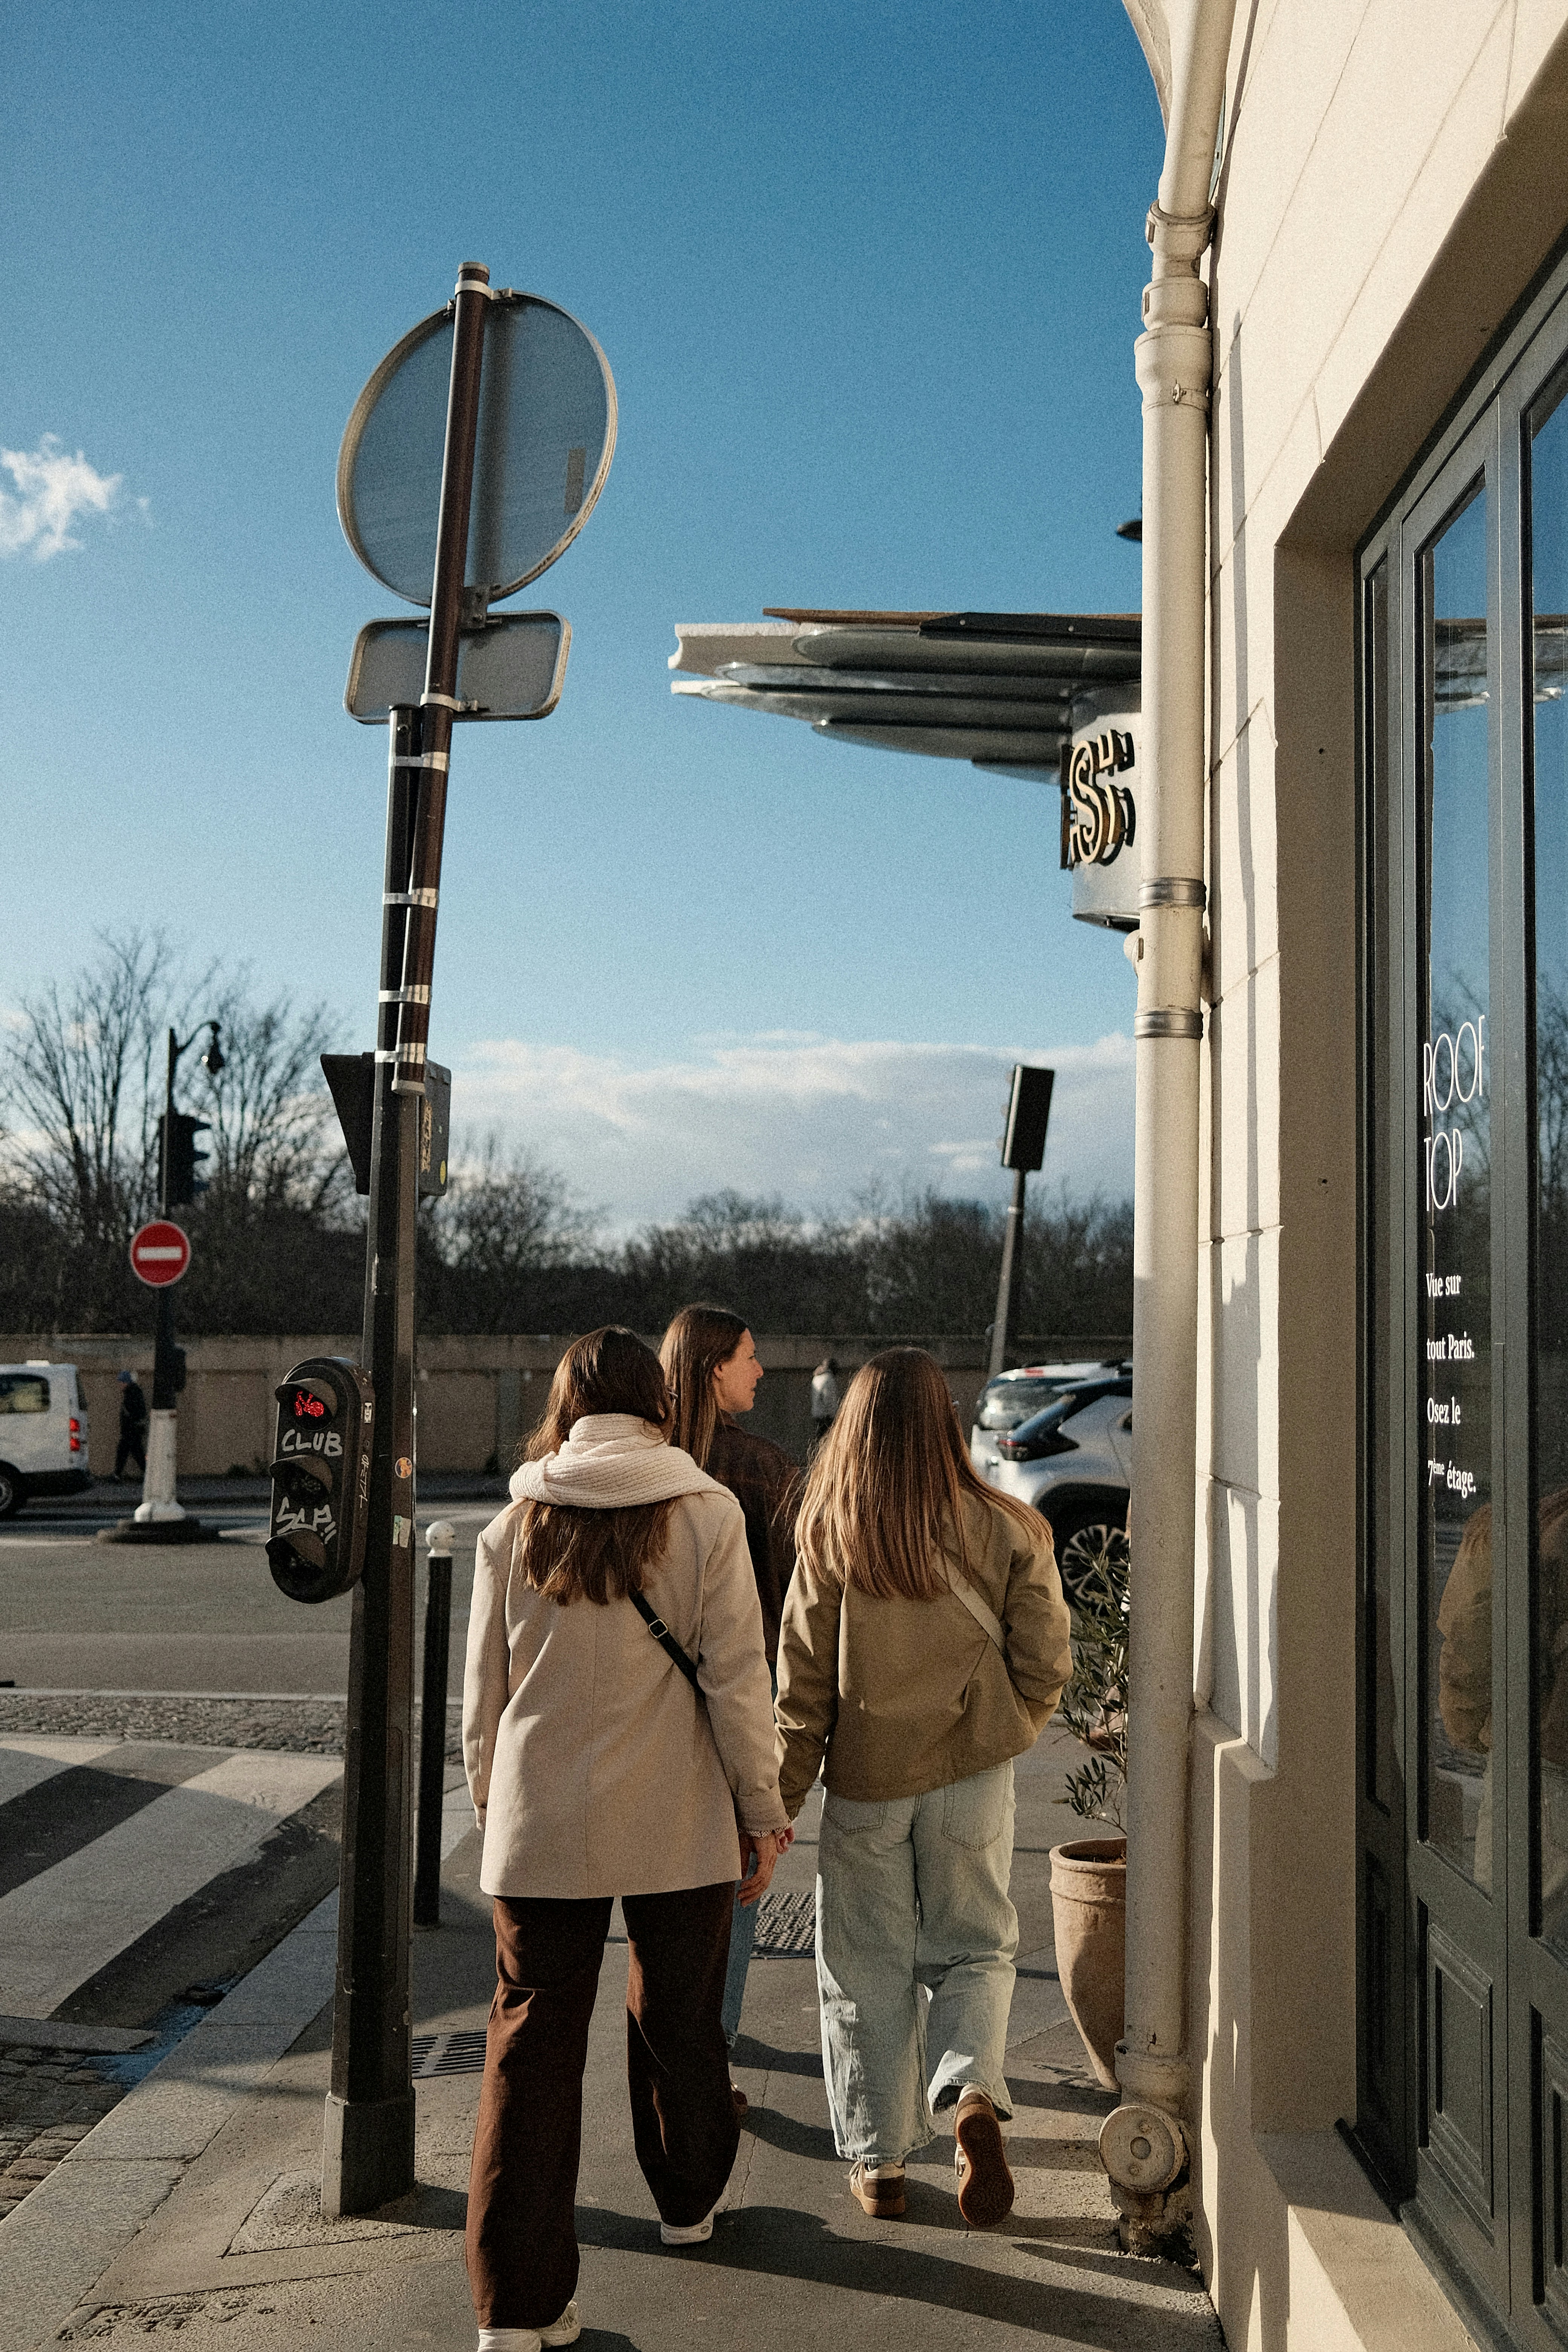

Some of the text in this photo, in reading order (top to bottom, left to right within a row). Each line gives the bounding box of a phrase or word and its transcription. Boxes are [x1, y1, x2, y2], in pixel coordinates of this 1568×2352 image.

[1424, 1015, 1485, 1116] ROOF
[1424, 1129, 1462, 1211] TOP
[1426, 1273, 1461, 1297] Vue sur
[1427, 1331, 1475, 1359] tout Paris.
[1427, 1396, 1461, 1424] Osez le
[282, 1429, 343, 1457] CLUB
[1428, 1458, 1476, 1499] 7ème étage.
